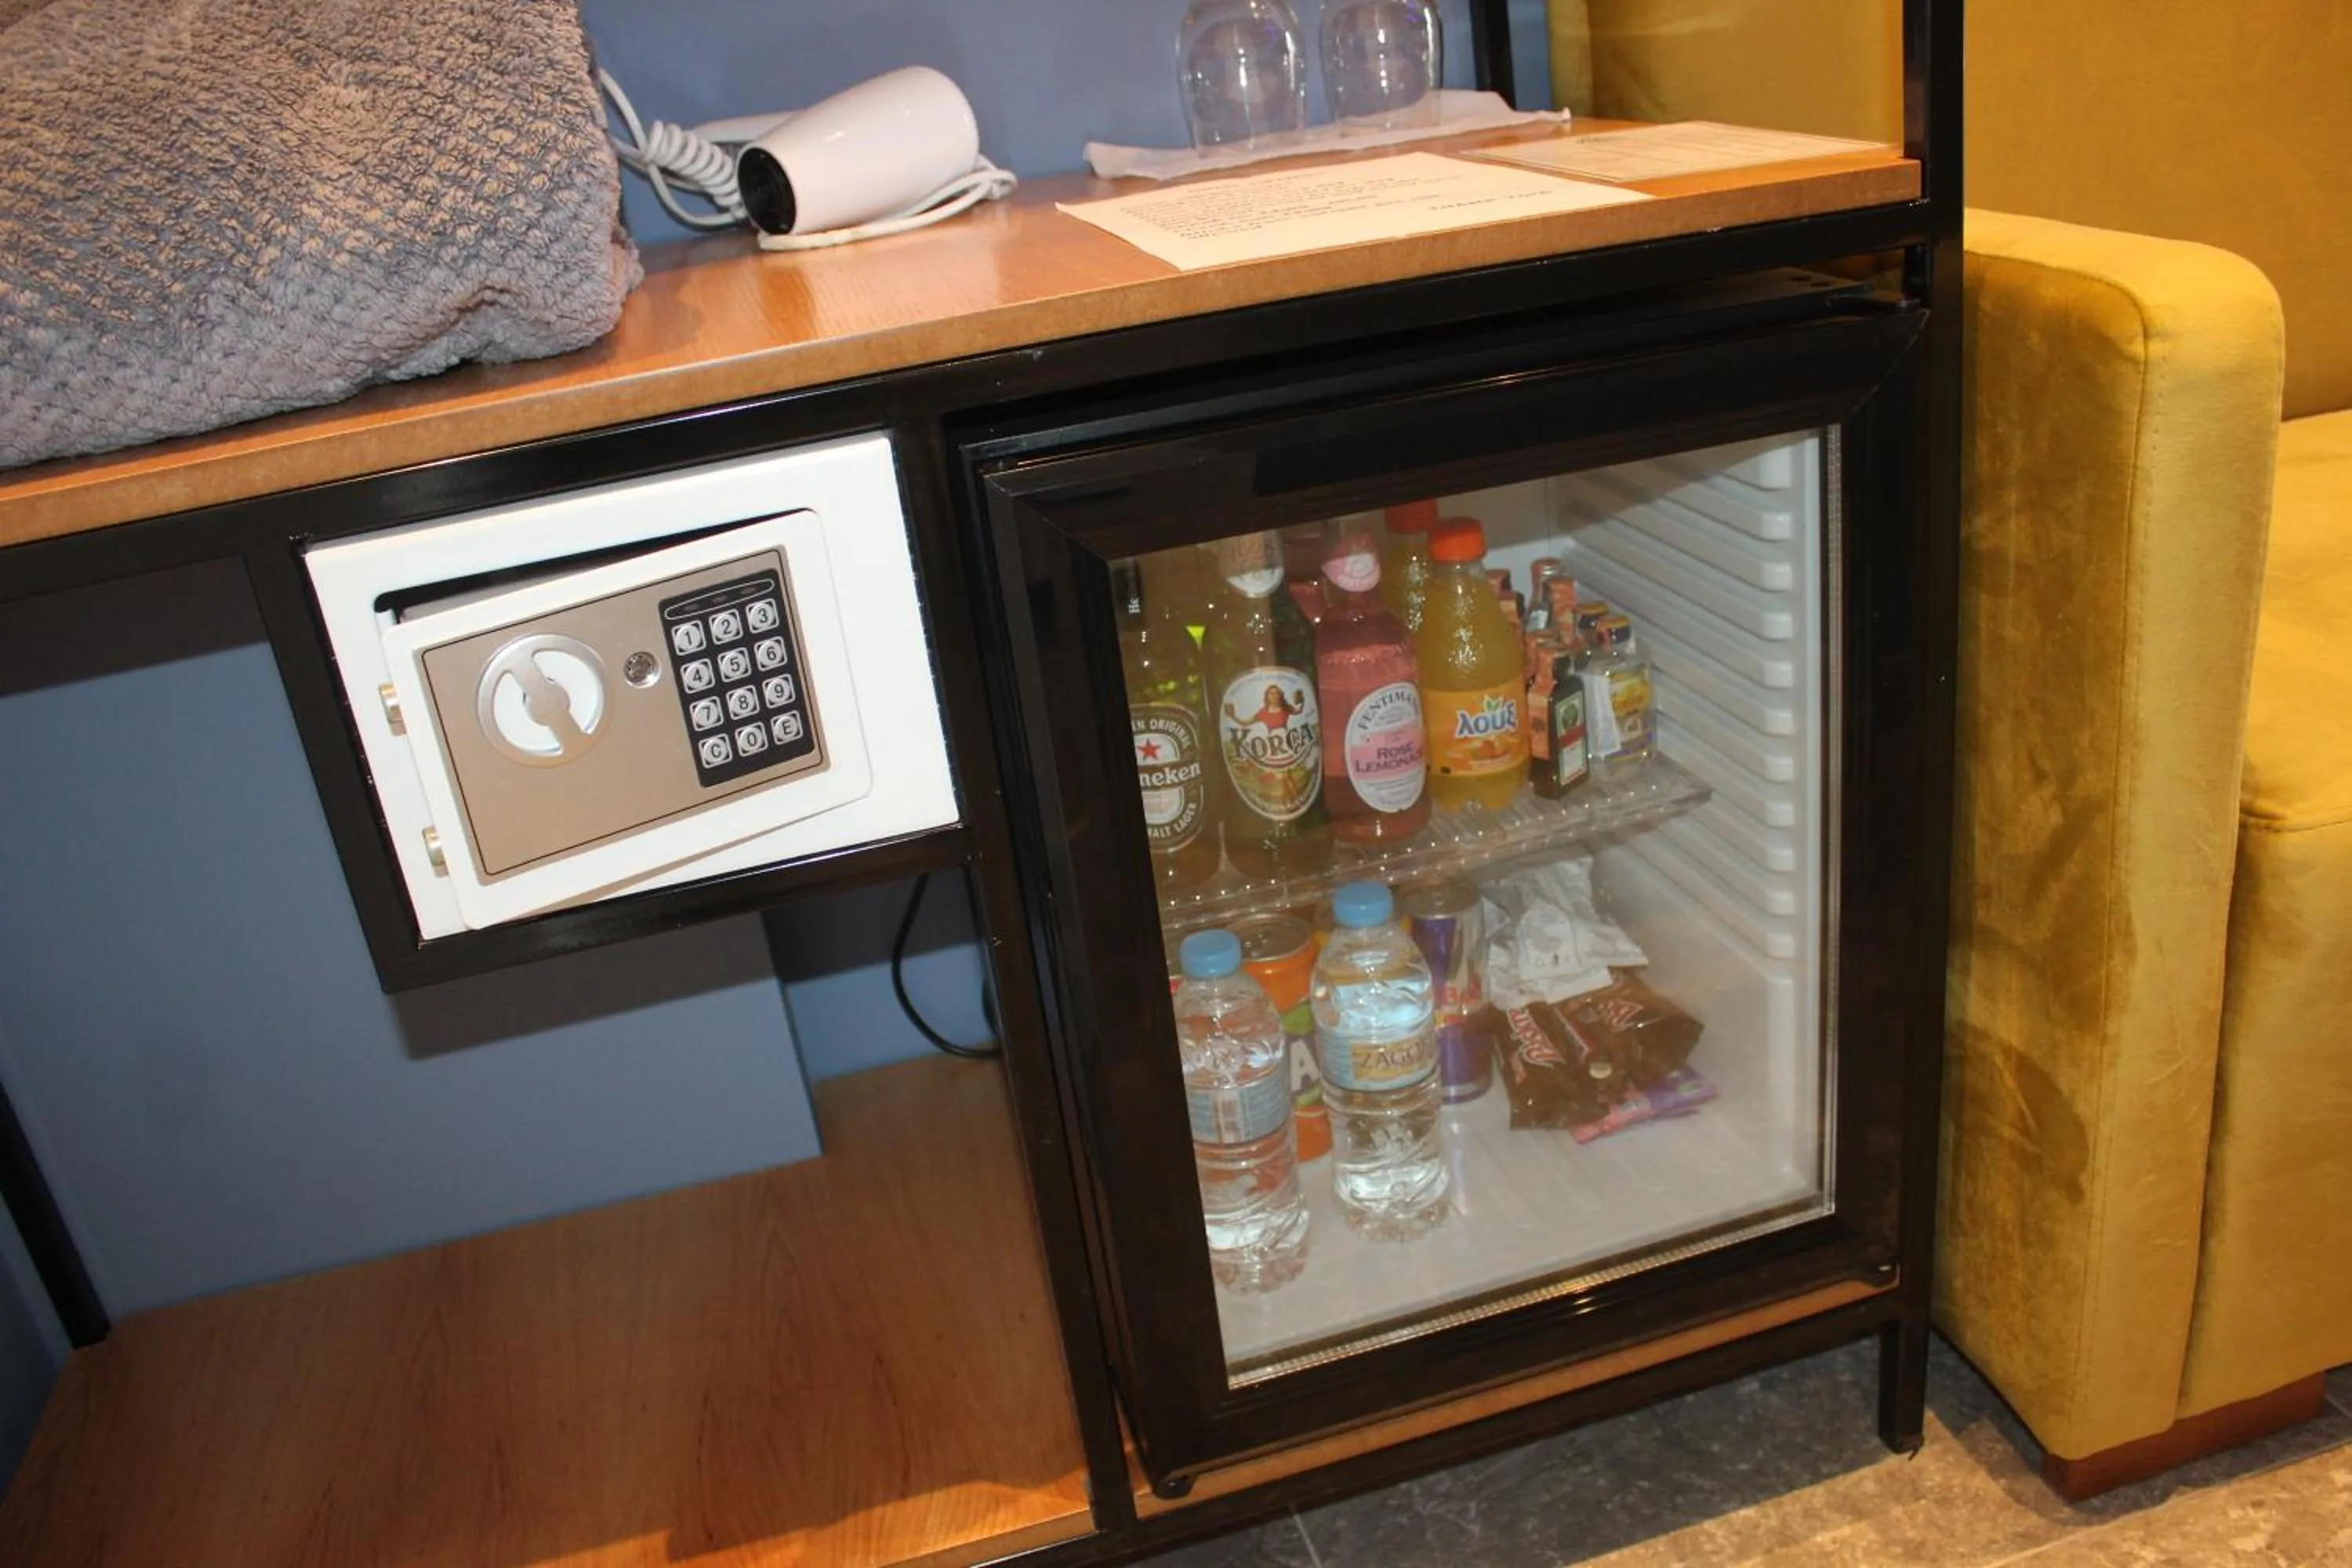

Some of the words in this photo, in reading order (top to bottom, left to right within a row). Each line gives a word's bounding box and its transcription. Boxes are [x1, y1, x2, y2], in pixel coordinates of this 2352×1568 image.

[684, 631, 693, 648] 1
[720, 619, 731, 636] 2
[758, 608, 769, 624] 3
[692, 668, 703, 684] 4
[730, 656, 741, 673] 5
[766, 645, 777, 662] 6
[702, 706, 712, 722] 7
[739, 694, 750, 710] 8
[774, 683, 785, 699] 9
[710, 743, 722, 759] C
[783, 720, 793, 736] E
[1149, 718, 1192, 748] ORIGINAL
[1138, 762, 1202, 787] neken
[1174, 801, 1198, 833] LAGER
